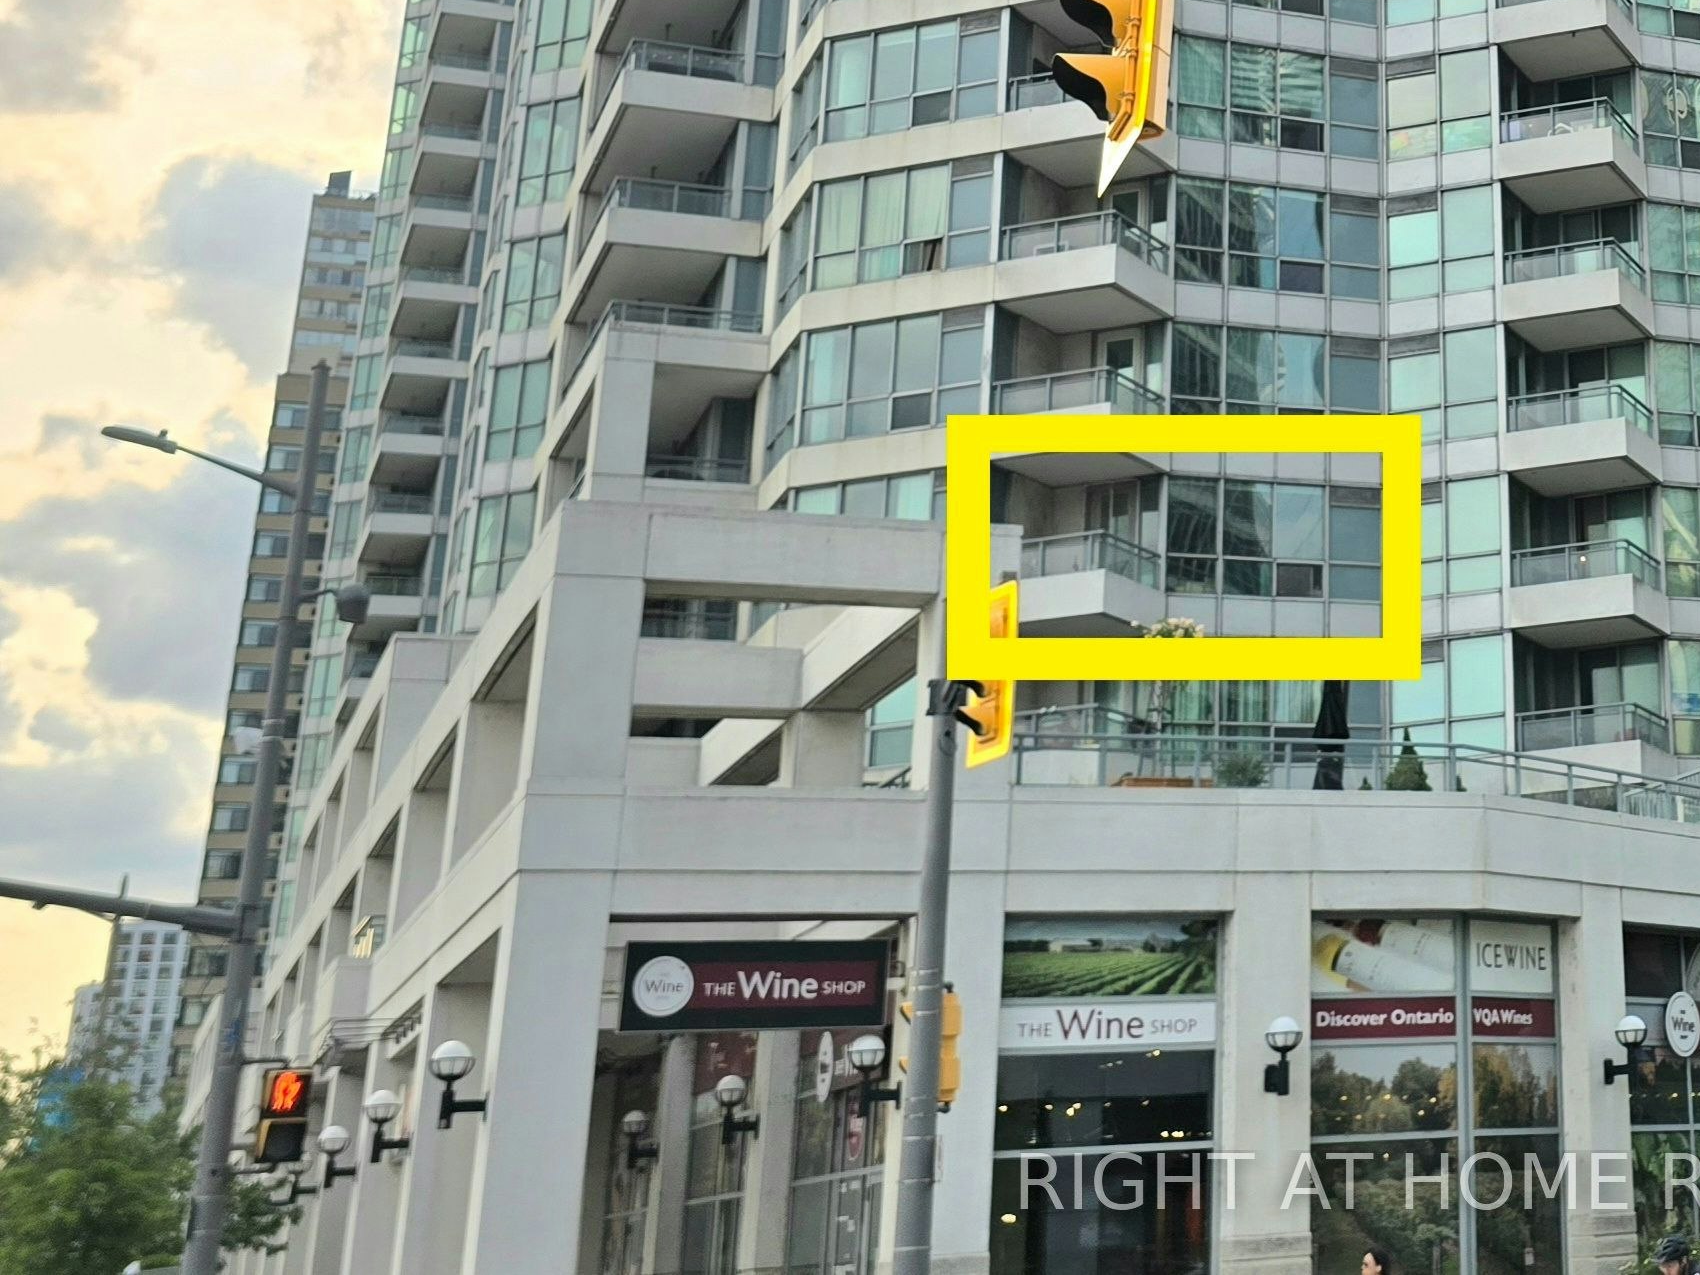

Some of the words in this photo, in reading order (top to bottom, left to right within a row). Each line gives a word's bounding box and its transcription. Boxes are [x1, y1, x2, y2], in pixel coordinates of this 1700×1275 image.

[1475, 942, 1547, 971] ICEWINE
[644, 979, 684, 993] Wine
[702, 981, 736, 998] THE
[737, 969, 819, 1001] Wine
[821, 980, 866, 996] SHOP
[1017, 1021, 1053, 1038] THE
[1055, 1008, 1145, 1041] Wine
[1150, 1017, 1198, 1035] SHOP
[1315, 1009, 1388, 1028] Discover
[1390, 1007, 1454, 1026] Ontario
[1472, 1008, 1500, 1027] VQA
[1499, 1008, 1533, 1026] Wines
[1671, 1016, 1695, 1033] Wine
